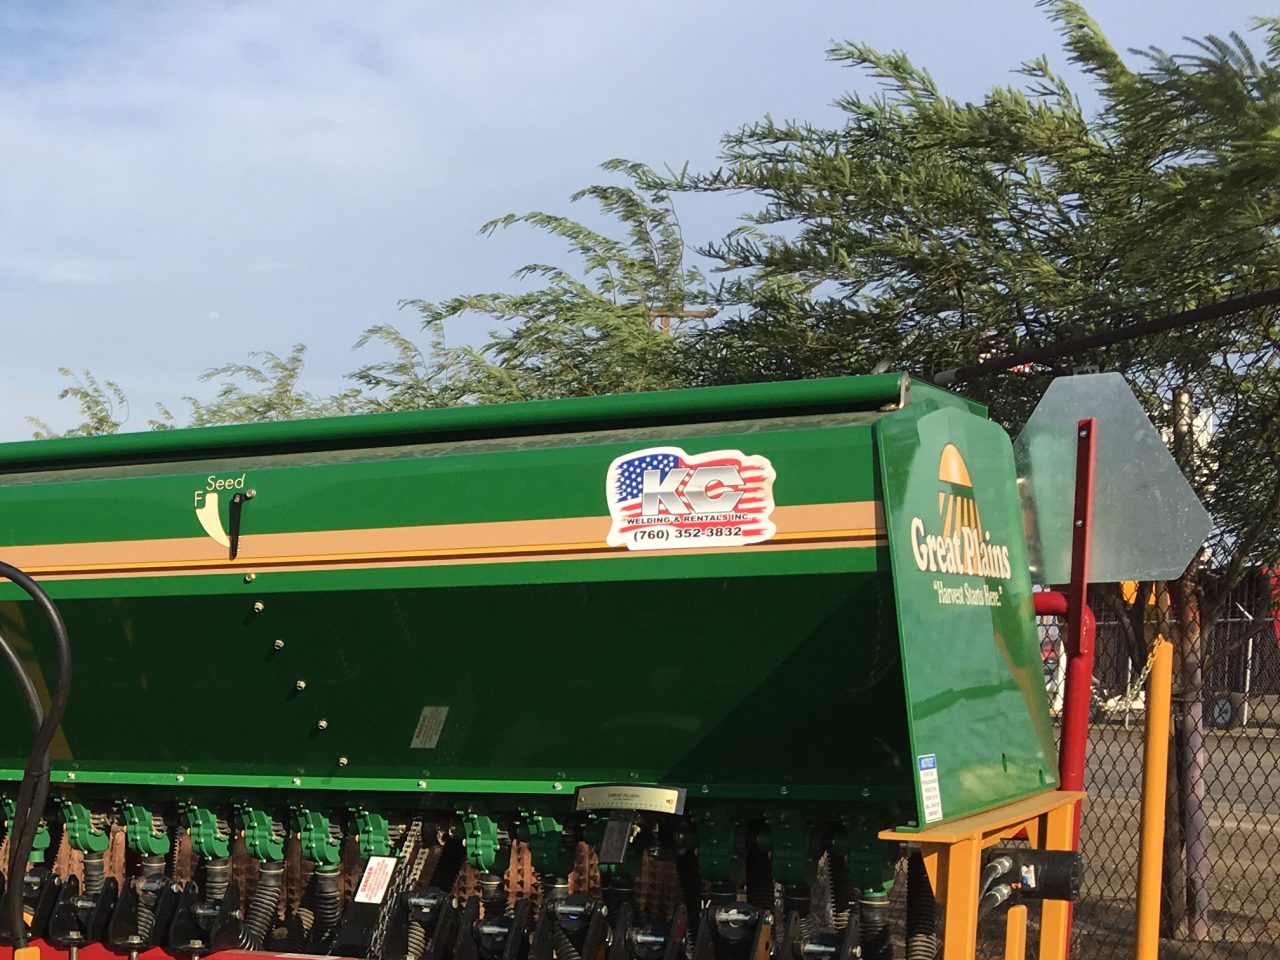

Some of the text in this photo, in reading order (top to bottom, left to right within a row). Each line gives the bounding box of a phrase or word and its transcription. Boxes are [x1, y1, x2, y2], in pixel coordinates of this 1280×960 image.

[206, 473, 246, 491] Seed
[642, 464, 746, 516] KC
[194, 490, 204, 508] F
[626, 516, 671, 525] WELDING
[683, 514, 728, 522] RENTALS
[634, 527, 741, 541] (760) 352-3832
[911, 517, 1011, 580] Great Plains
[964, 582, 985, 606] Starts
